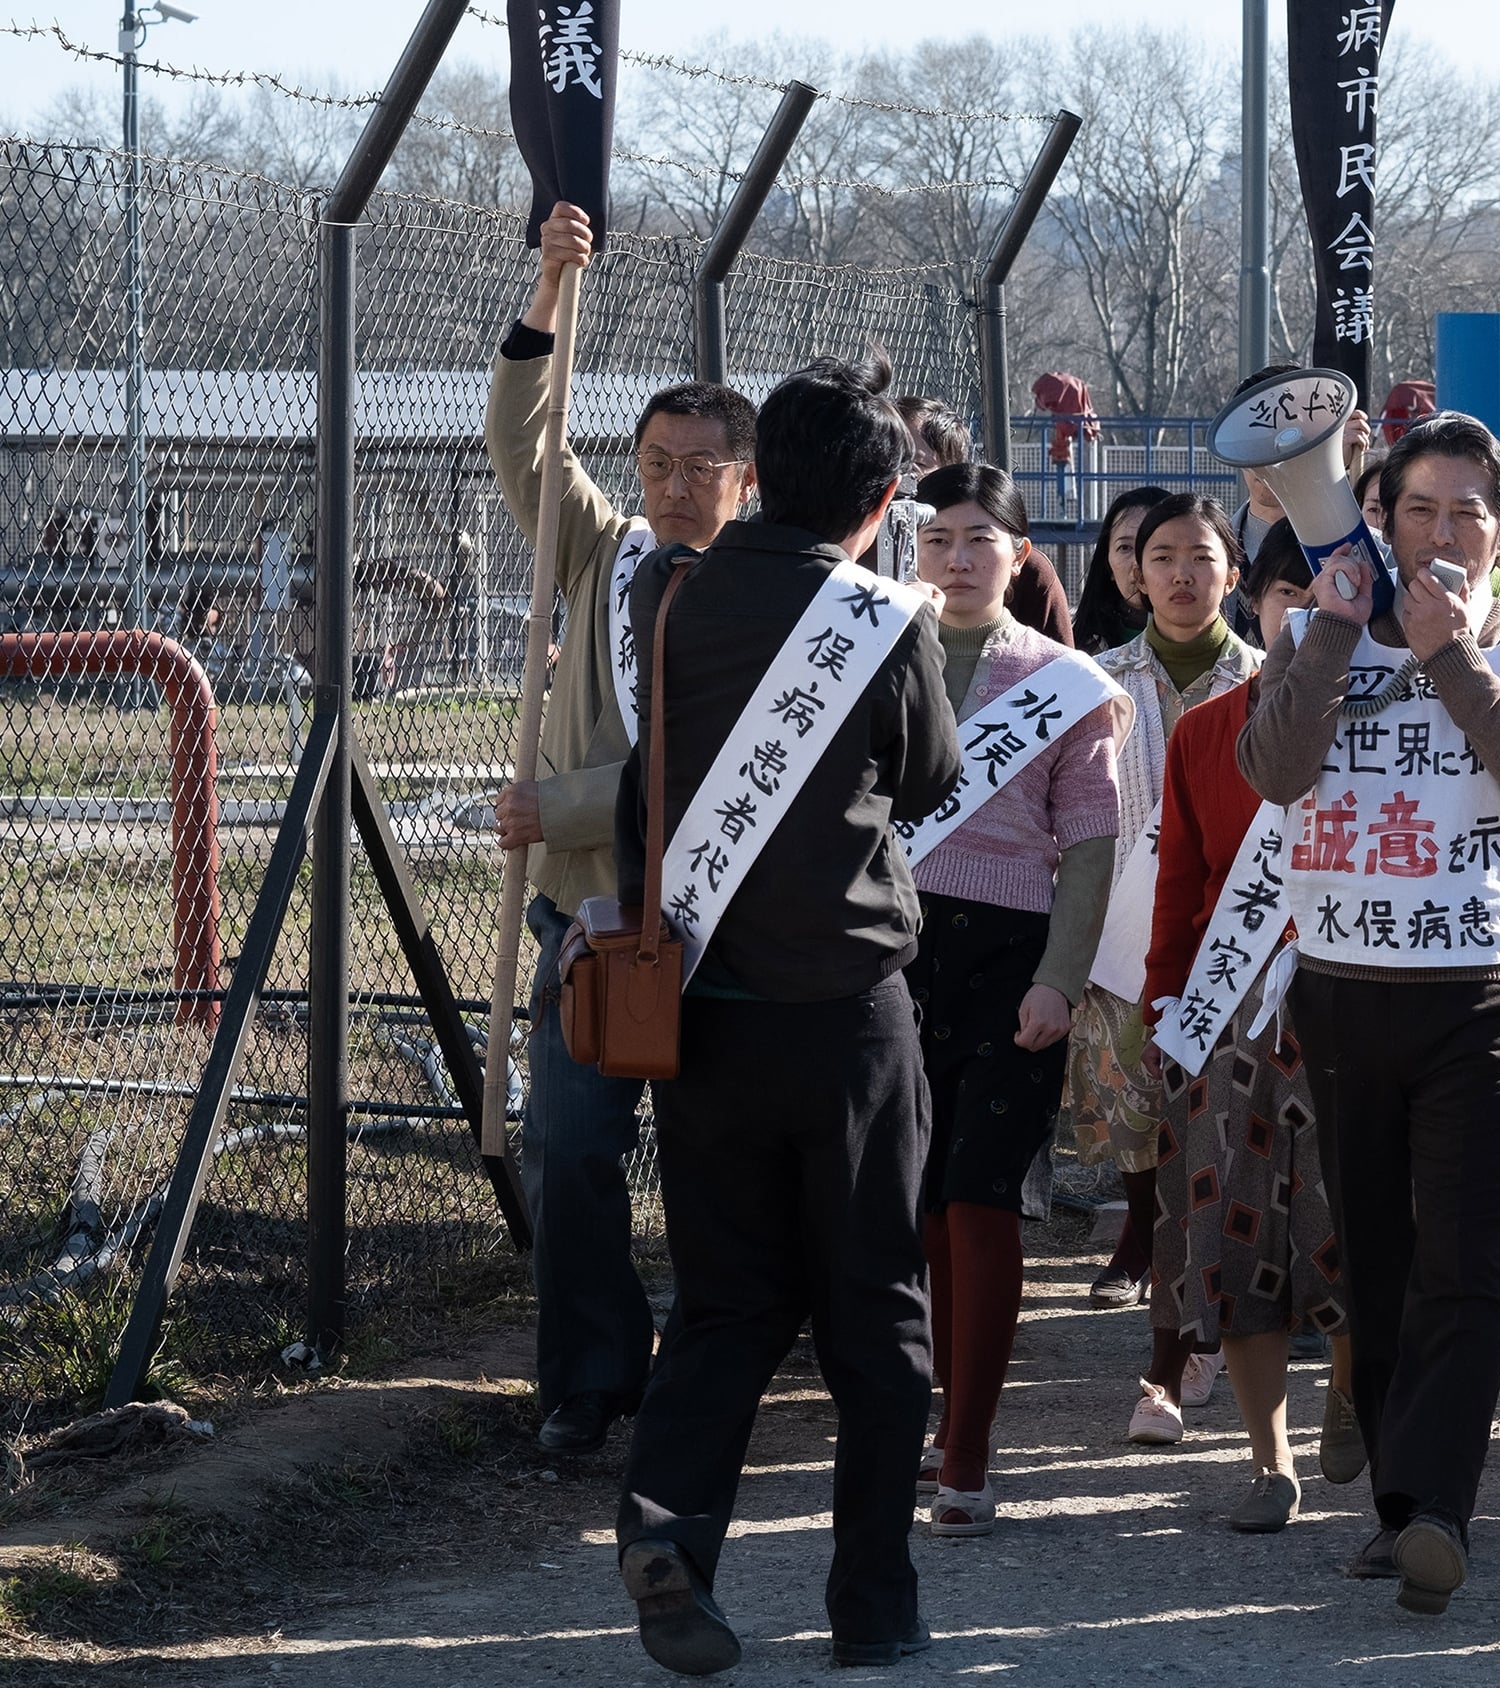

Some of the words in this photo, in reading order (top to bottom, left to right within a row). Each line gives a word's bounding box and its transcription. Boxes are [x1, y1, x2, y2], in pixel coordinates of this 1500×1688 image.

[1326, 0, 1382, 346] 病市民会議
[668, 582, 890, 940] 水俣病患者代表
[1321, 721, 1485, 776] 世界に
